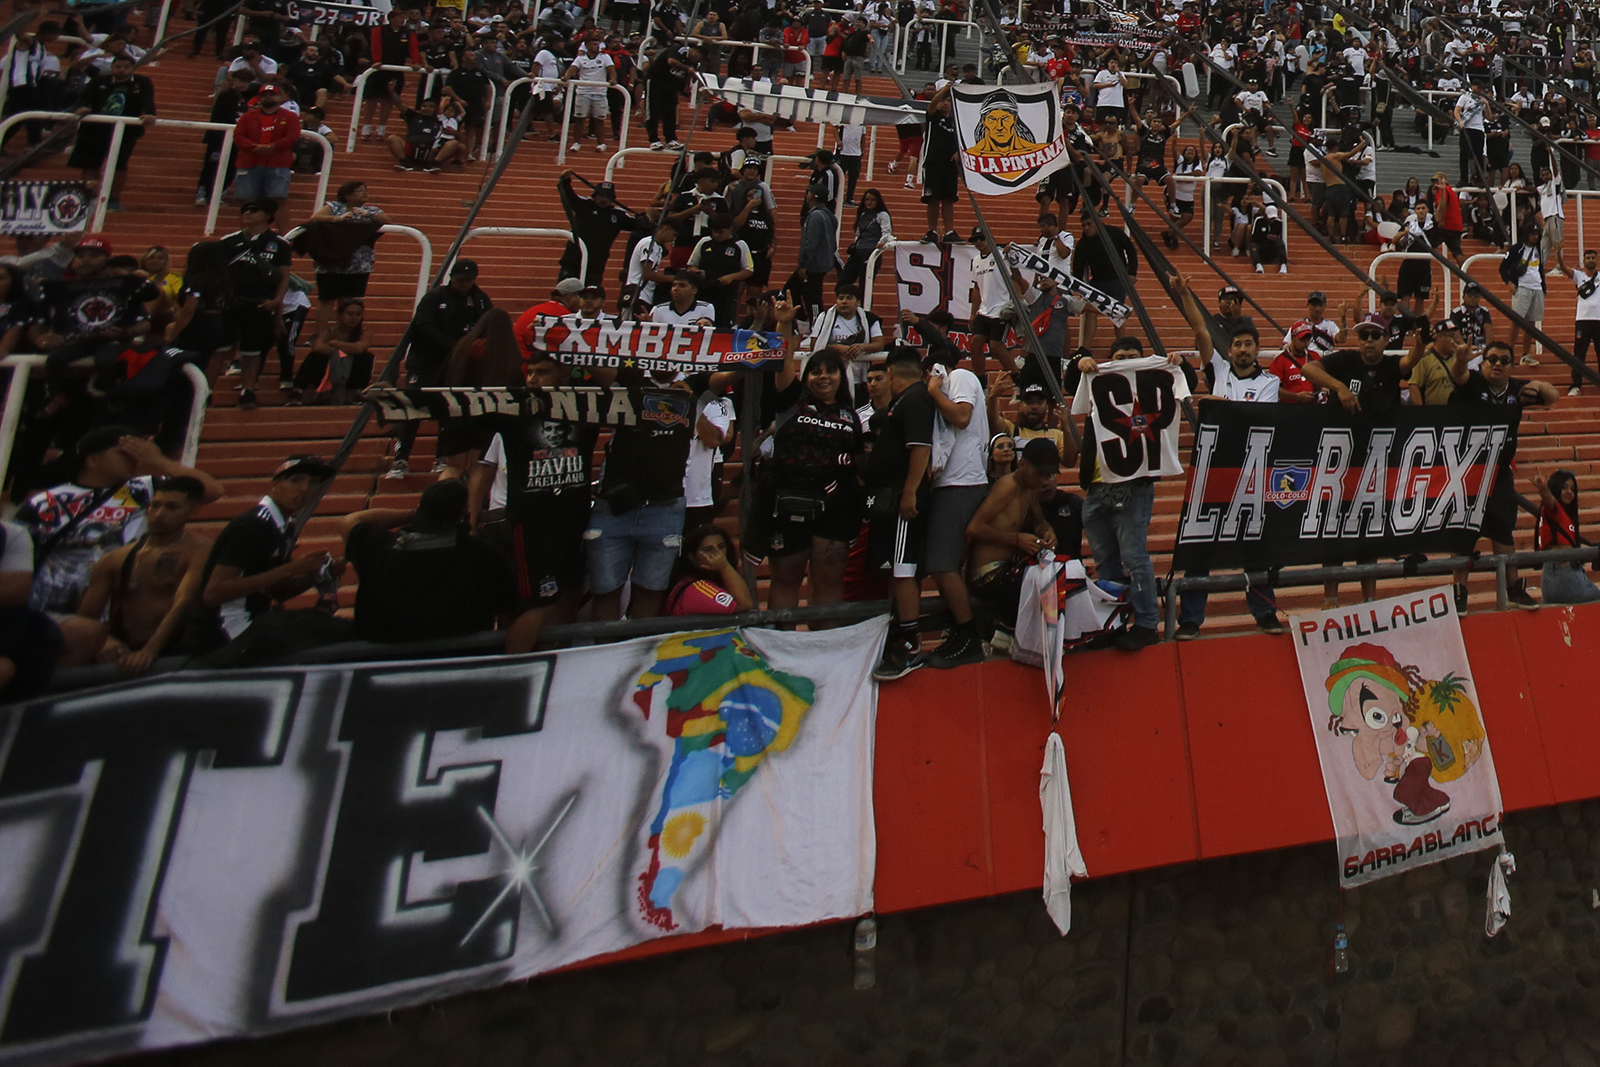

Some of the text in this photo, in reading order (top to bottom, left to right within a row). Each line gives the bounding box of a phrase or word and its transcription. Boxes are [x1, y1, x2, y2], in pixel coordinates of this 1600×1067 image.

[979, 156, 1000, 174] LA
[1000, 139, 1065, 173] PINTANA
[638, 358, 719, 372] SIEMPRE
[1091, 369, 1176, 477] SP
[526, 471, 585, 488] ARELLANO
[528, 455, 584, 478] DAVID
[1179, 424, 1275, 544] LA
[1300, 592, 1449, 646] PAILLACO
